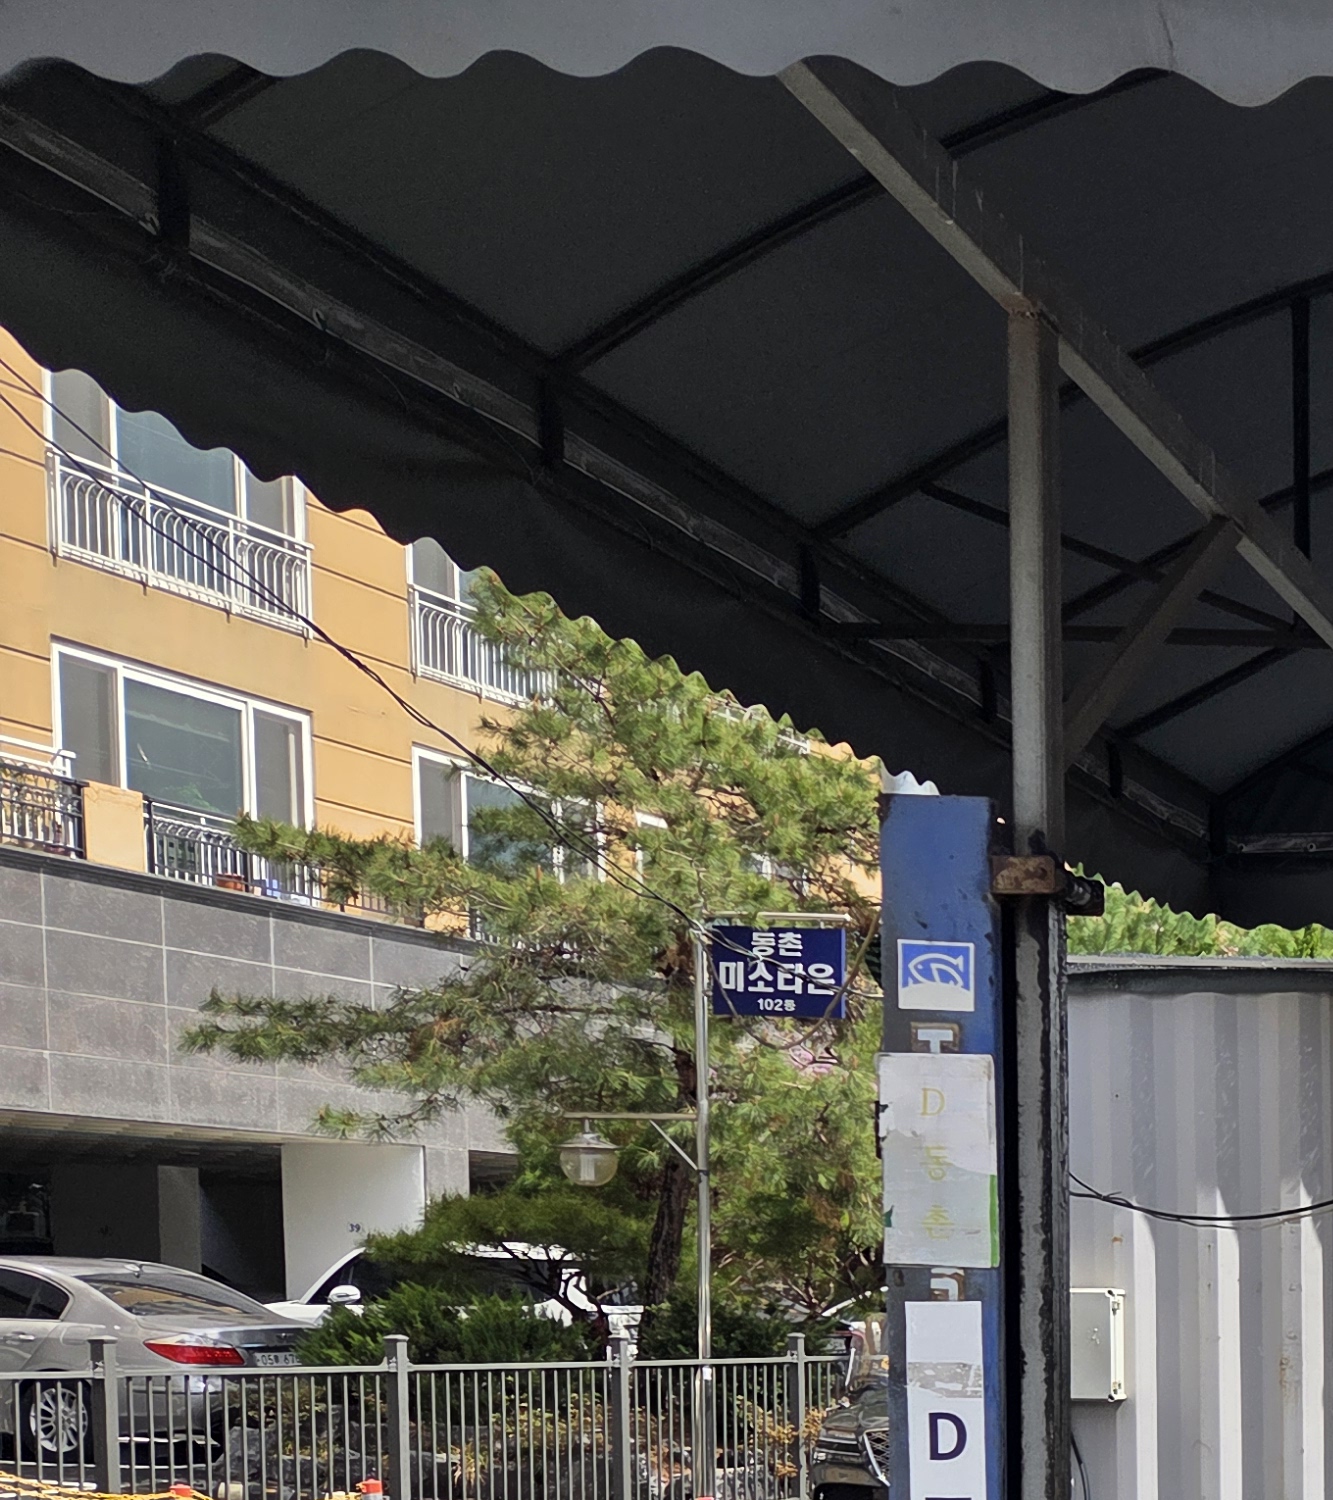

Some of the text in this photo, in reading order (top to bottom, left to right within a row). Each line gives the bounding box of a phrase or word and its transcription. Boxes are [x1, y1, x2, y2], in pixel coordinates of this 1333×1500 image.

[751, 932, 803, 957] 동촌
[719, 960, 836, 996] 미소타운
[757, 998, 796, 1012] 102동
